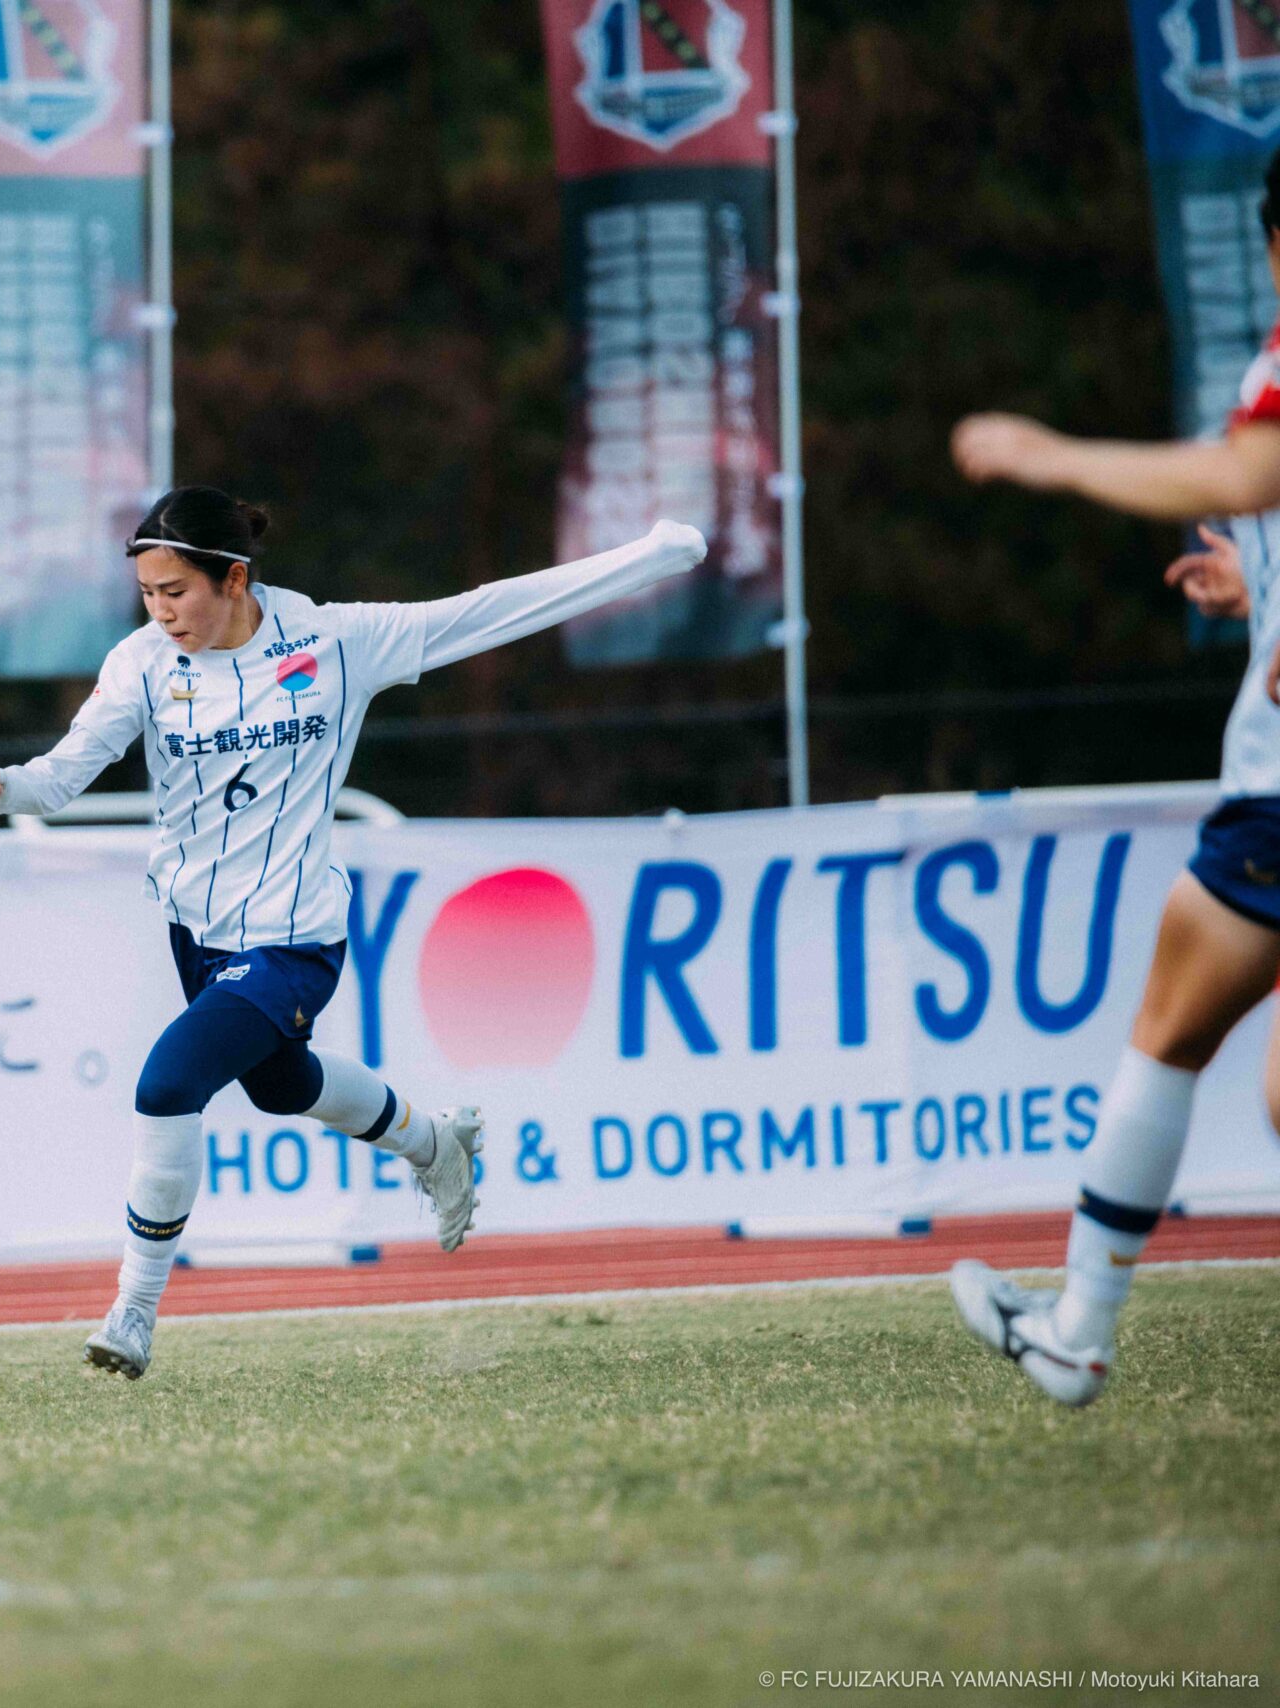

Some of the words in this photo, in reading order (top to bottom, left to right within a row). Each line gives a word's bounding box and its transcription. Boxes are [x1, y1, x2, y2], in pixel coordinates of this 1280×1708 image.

[164, 714, 329, 759] 富士観光開発
[223, 763, 259, 813] 6
[519, 1120, 559, 1184] &
[592, 1085, 1101, 1181] DORMITORIES
